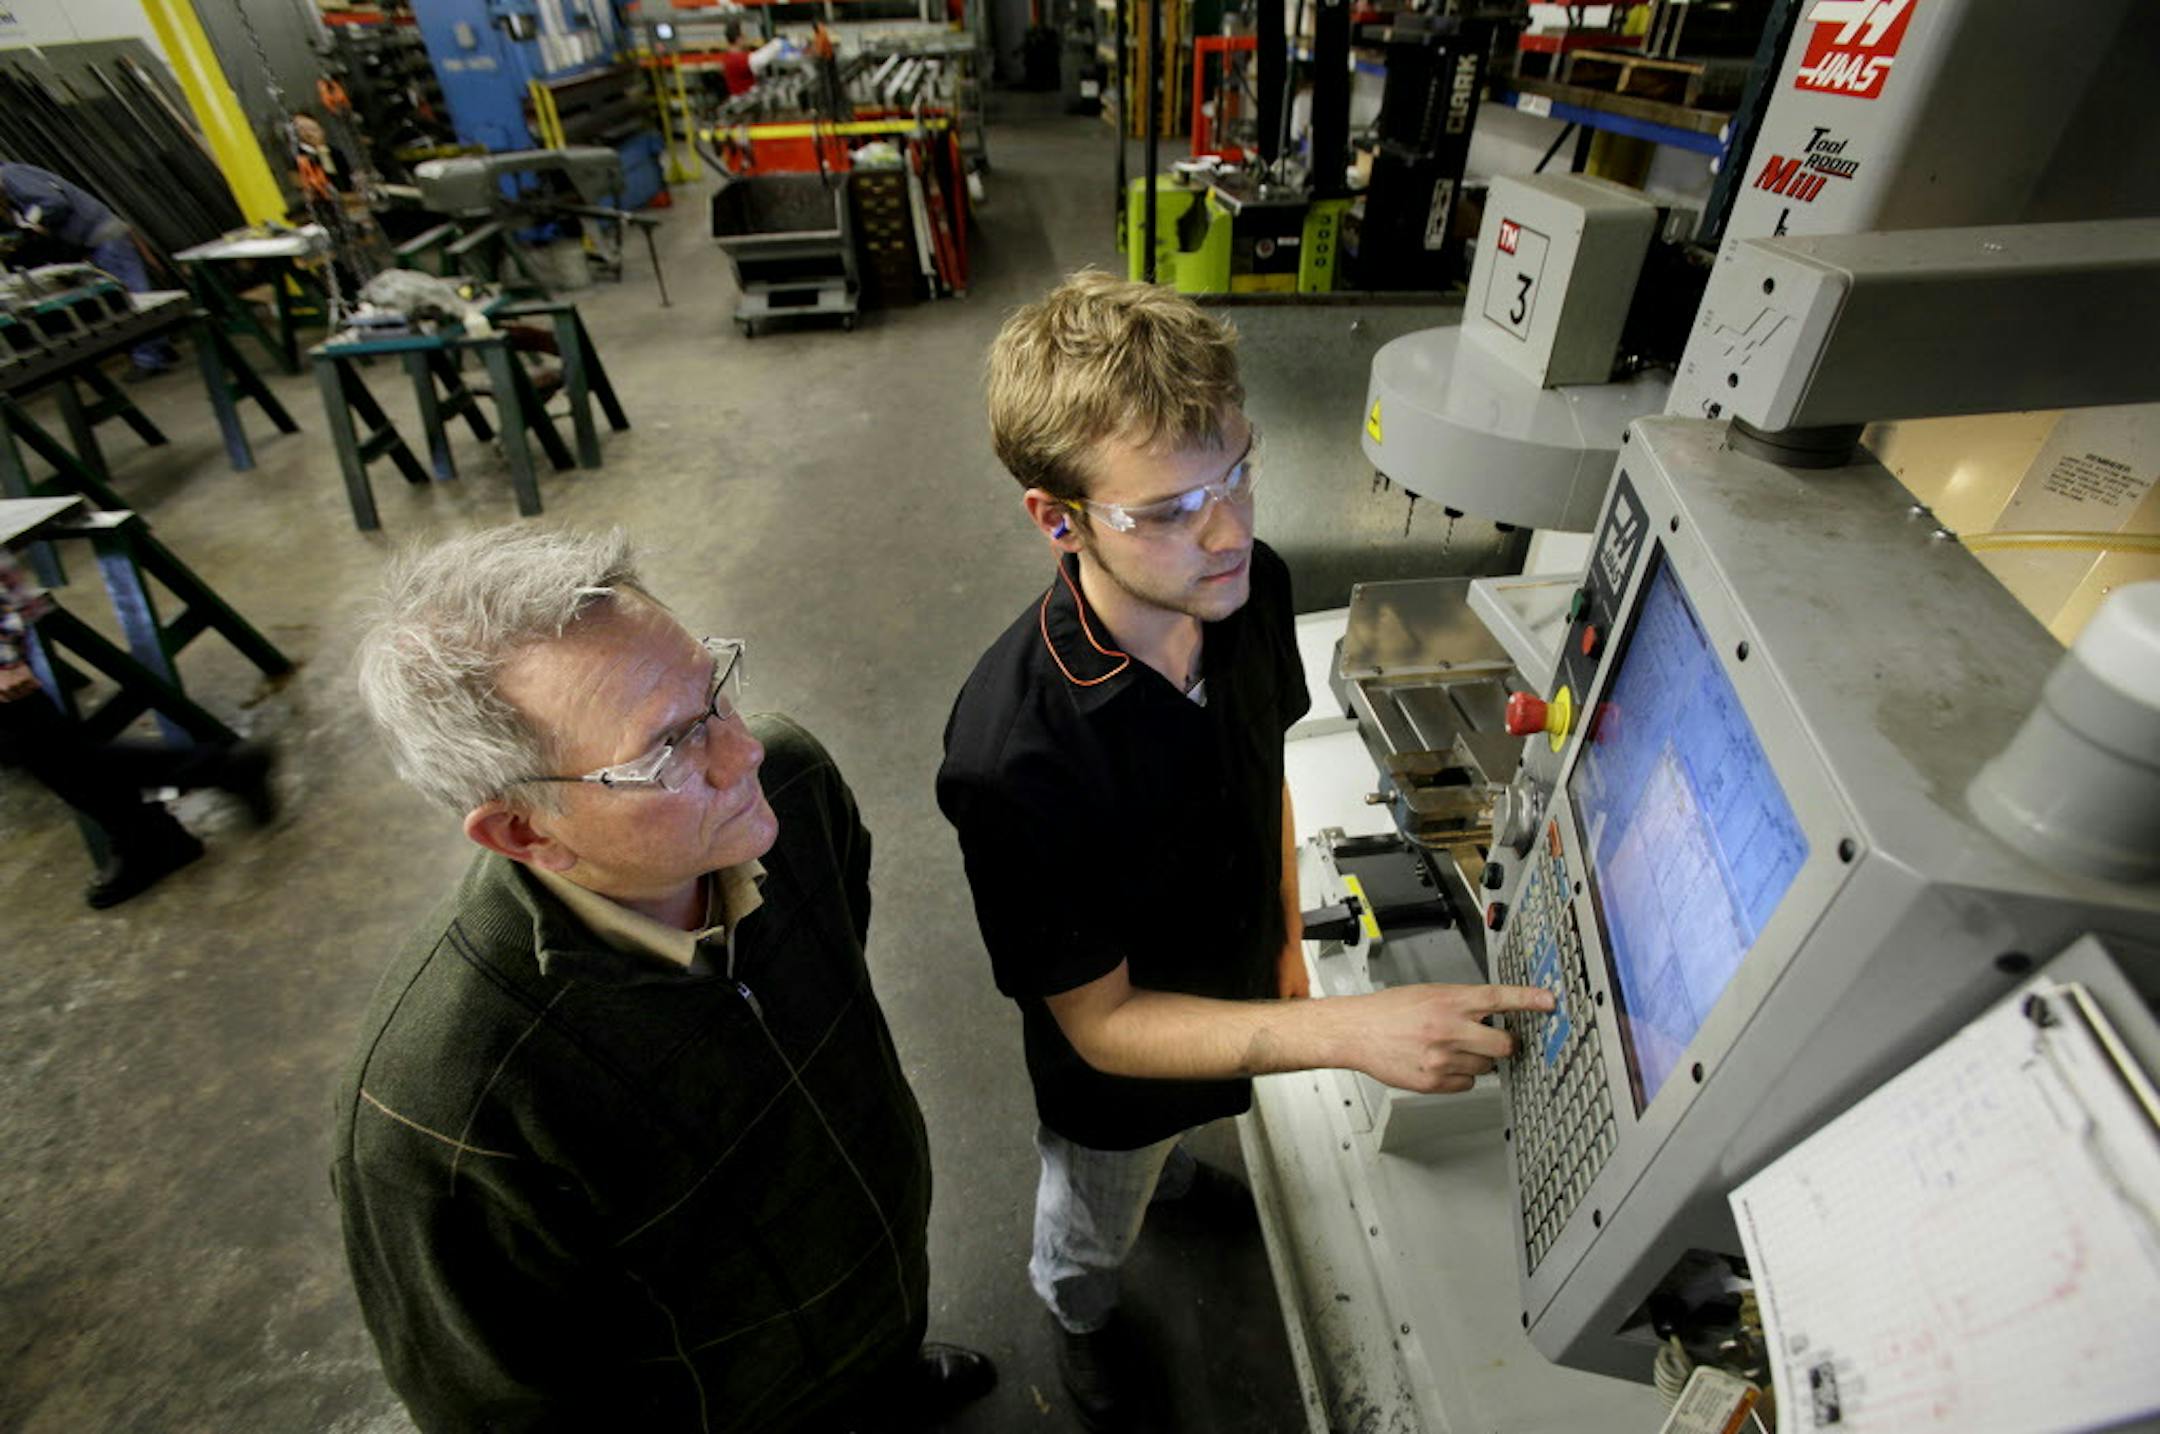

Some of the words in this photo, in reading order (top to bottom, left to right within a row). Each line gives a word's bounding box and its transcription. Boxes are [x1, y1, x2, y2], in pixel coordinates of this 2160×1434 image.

[1446, 54, 1478, 133] CLARK
[1798, 51, 1894, 92] HAAS
[1804, 127, 1848, 154] Tool
[1753, 154, 1827, 202] Mill
[1509, 271, 1533, 325] 3
